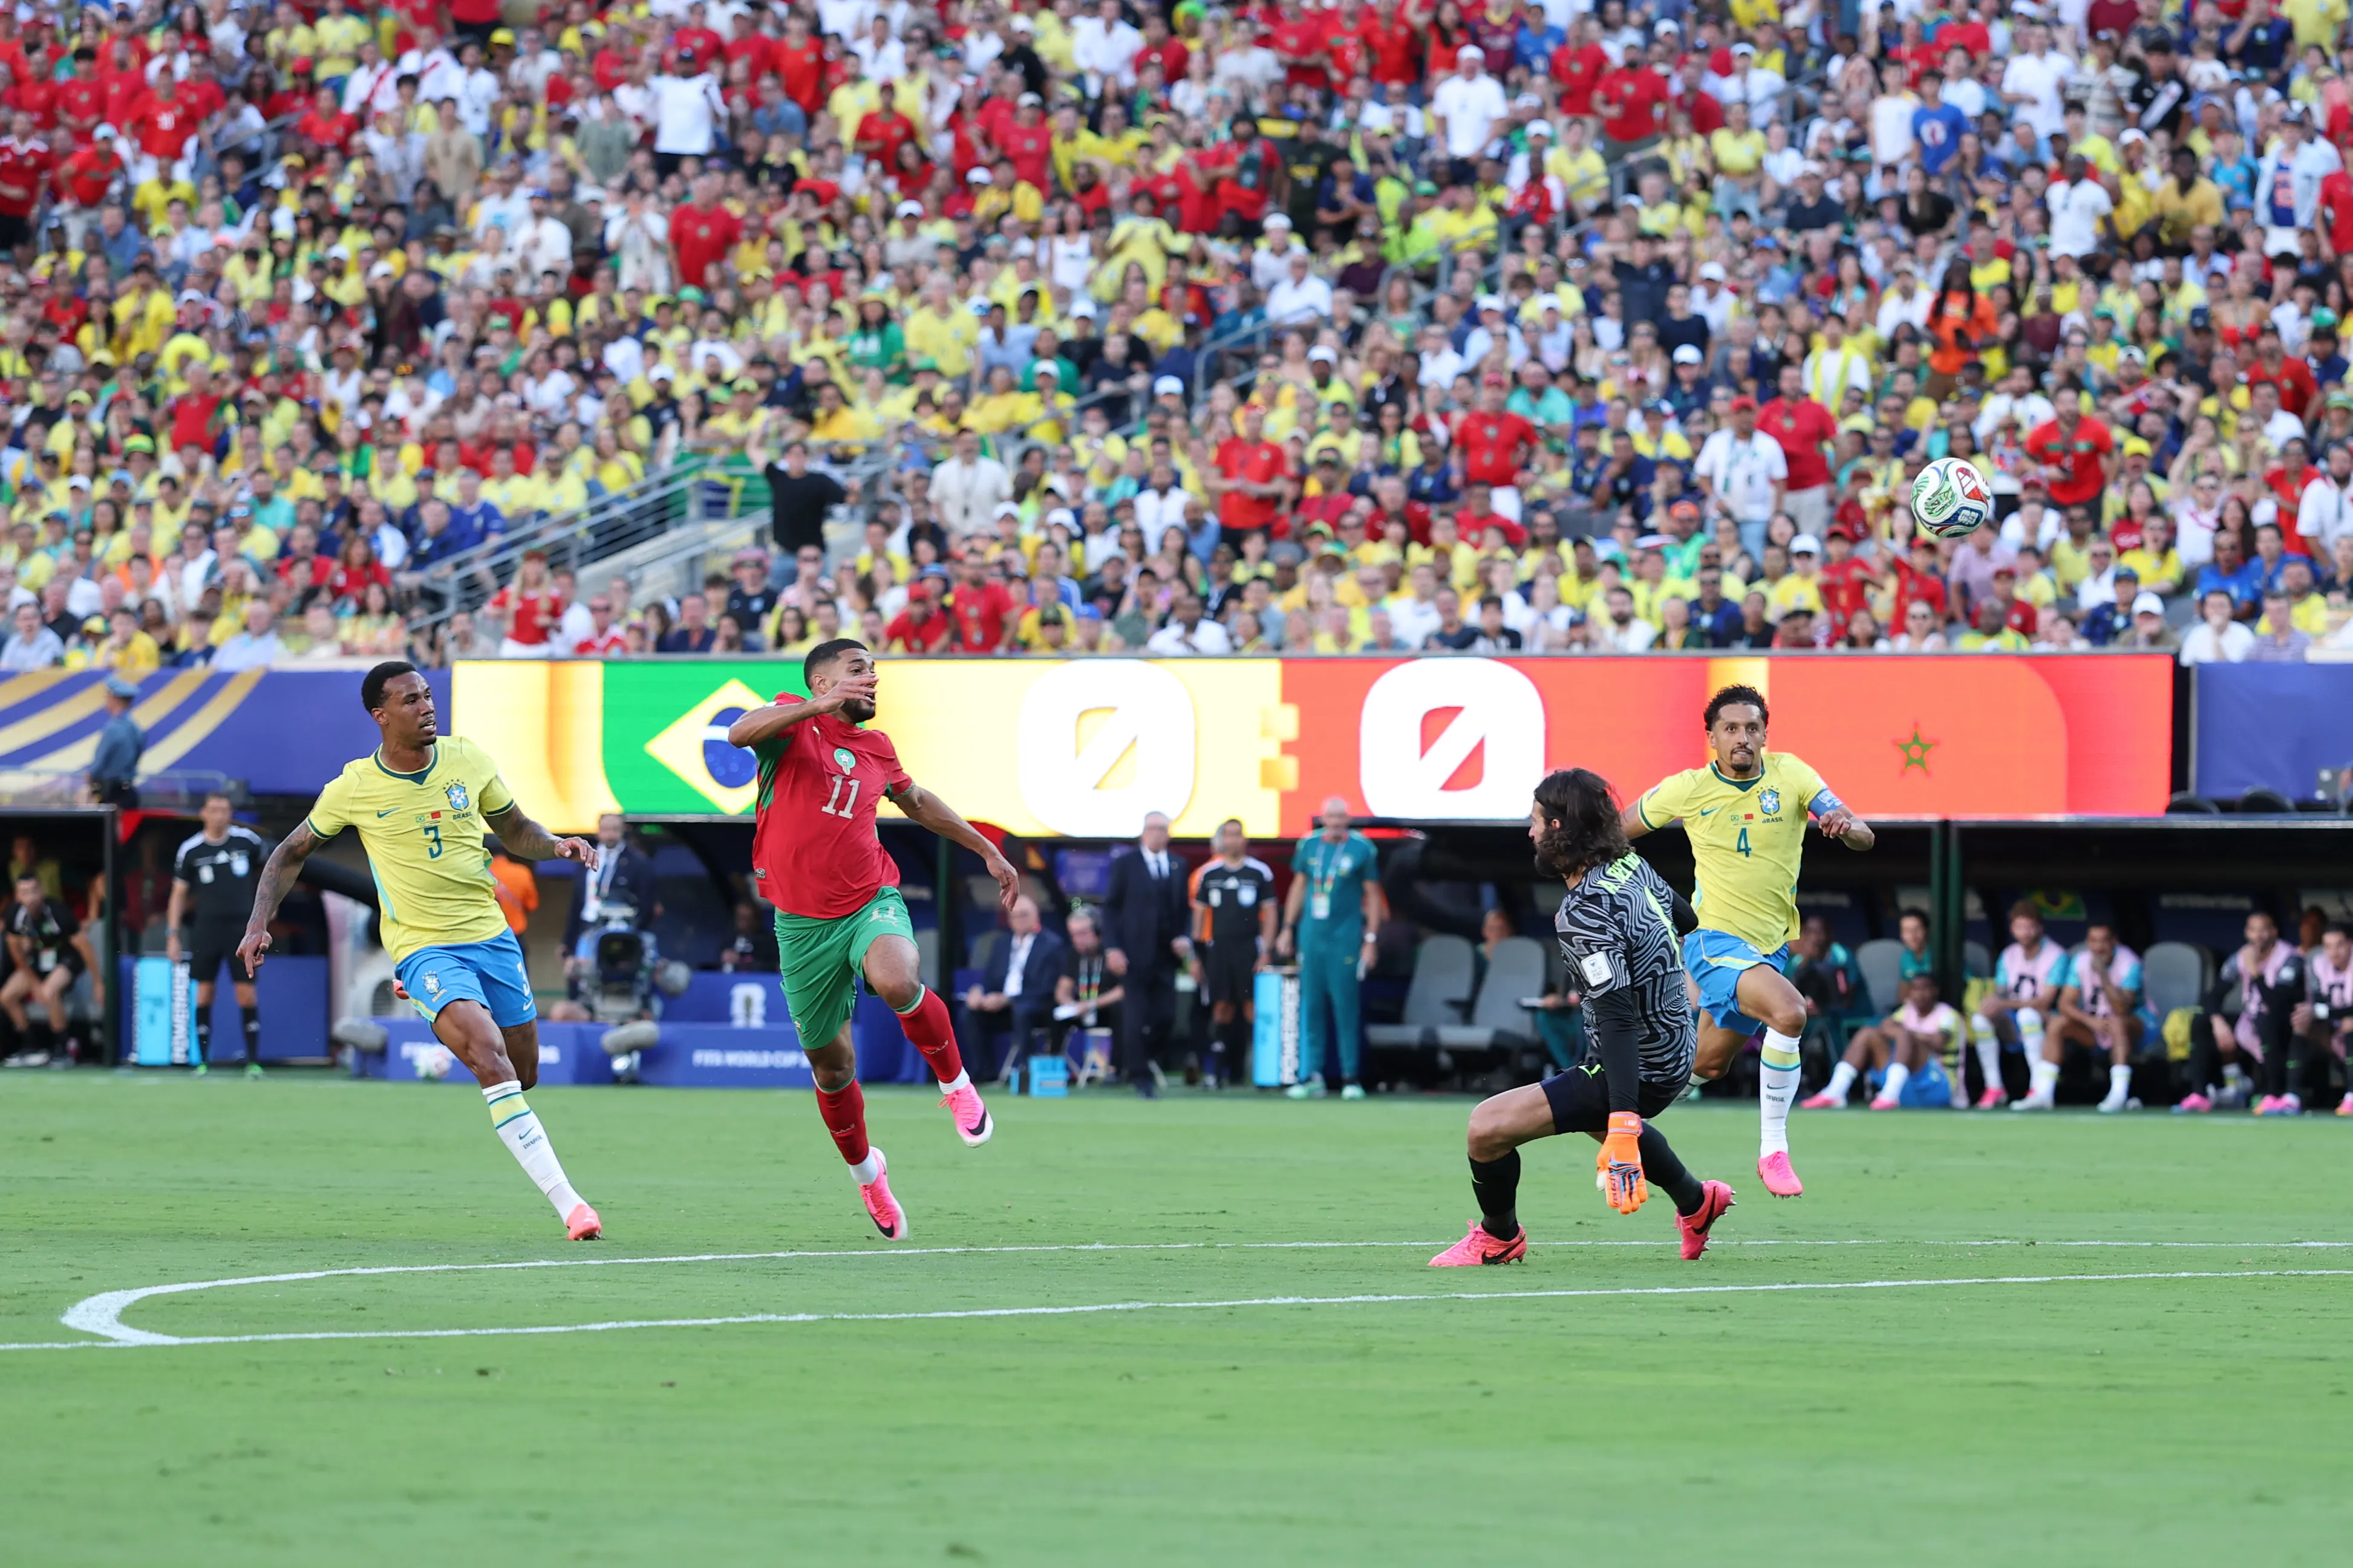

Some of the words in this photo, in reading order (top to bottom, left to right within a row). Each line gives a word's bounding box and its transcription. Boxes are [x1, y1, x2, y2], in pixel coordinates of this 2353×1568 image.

[821, 775, 861, 819] 11
[452, 812, 473, 821] BRASIL
[424, 825, 443, 859] 3
[1737, 827, 1752, 858] 4
[1643, 885, 1683, 969] 1
[523, 1135, 543, 1150] BRASIL
